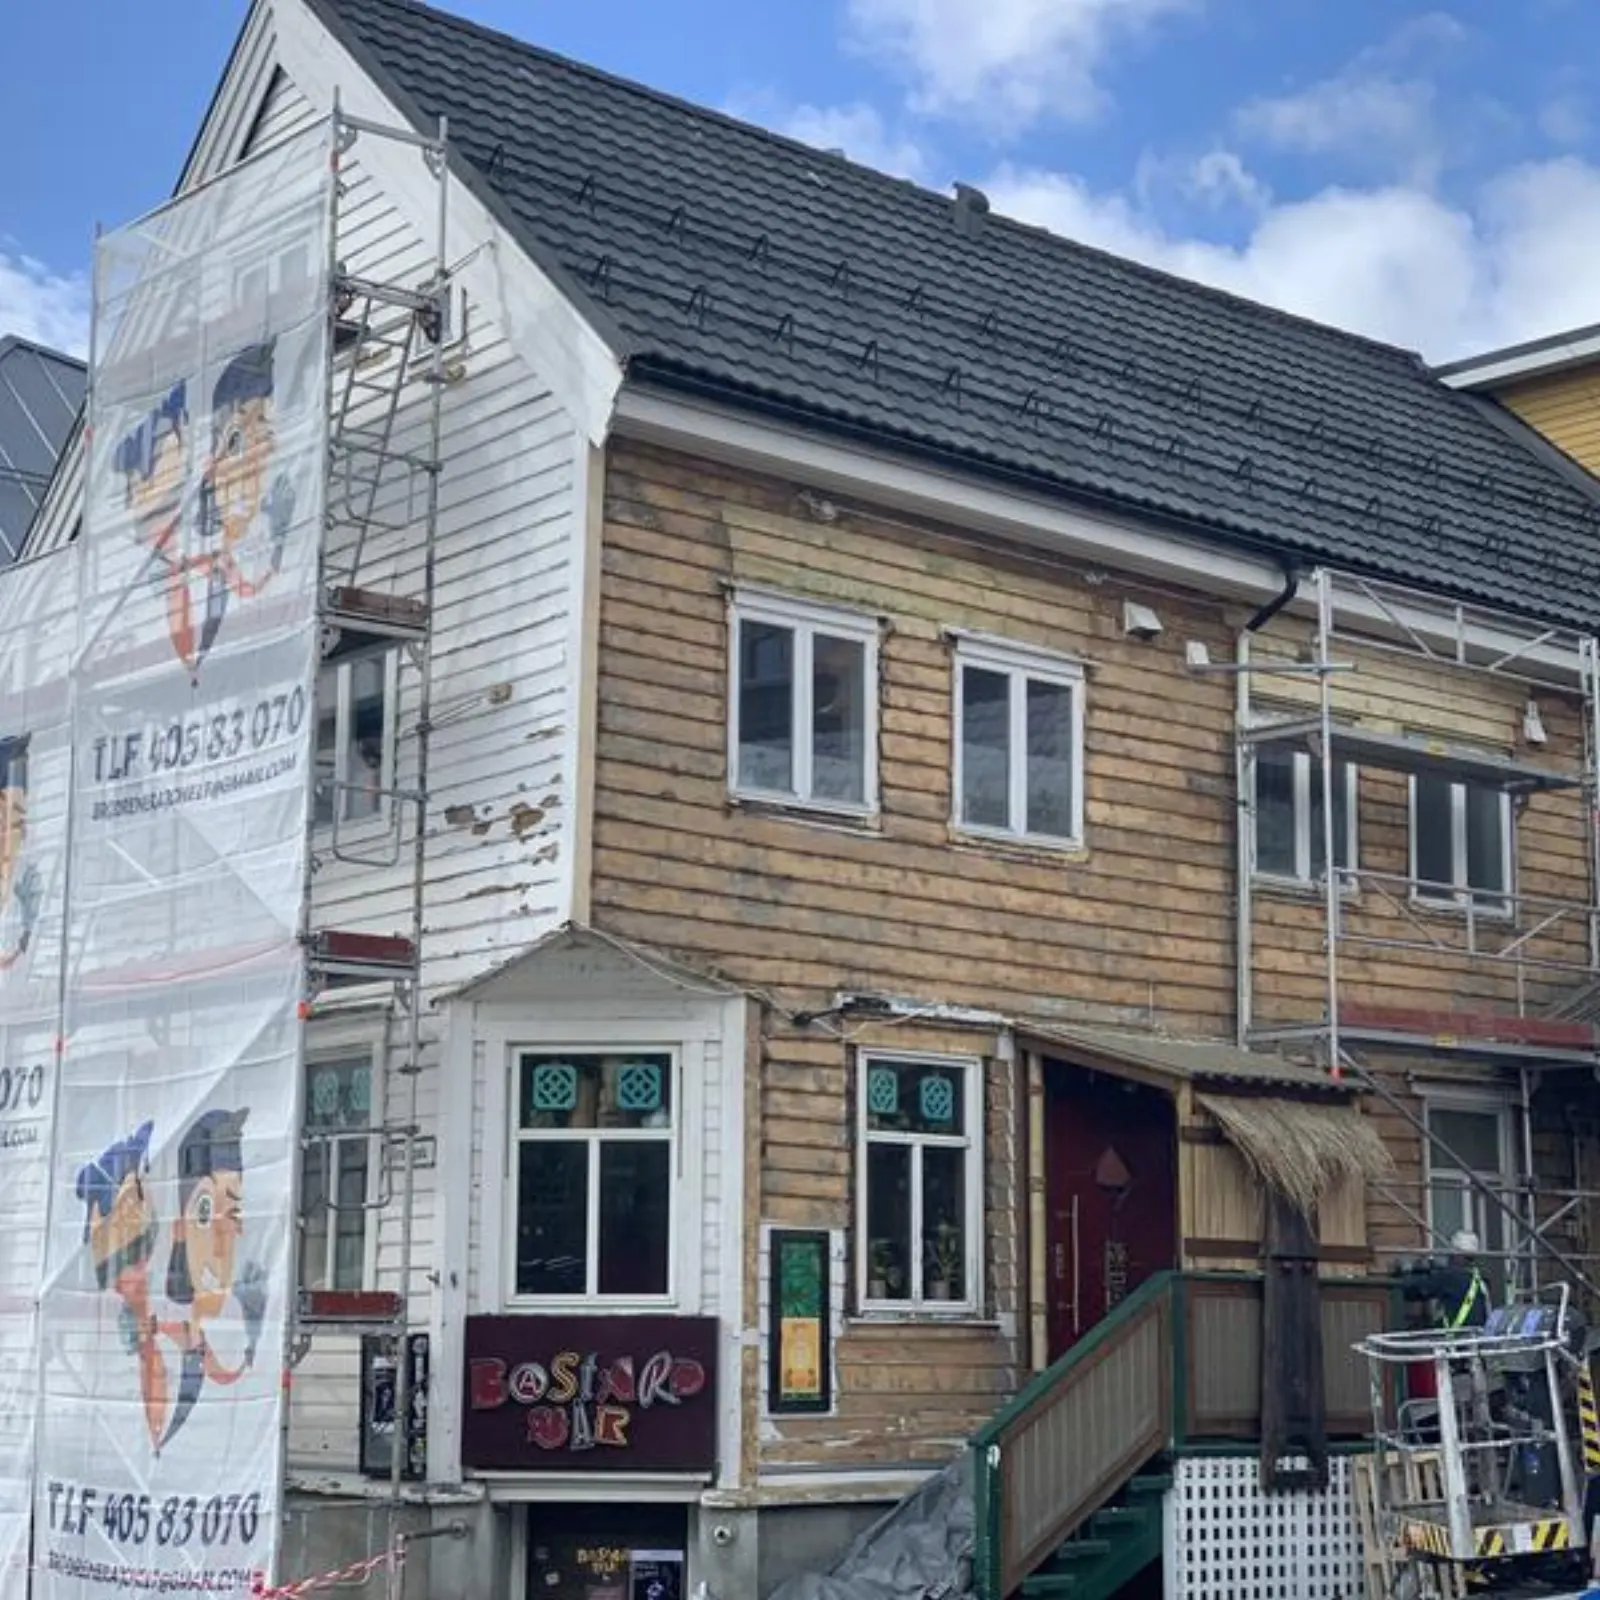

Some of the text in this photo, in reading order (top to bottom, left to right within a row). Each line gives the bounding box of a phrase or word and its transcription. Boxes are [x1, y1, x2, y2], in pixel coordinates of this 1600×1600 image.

[93, 684, 304, 781] TLF 405 83 070
[48, 1481, 261, 1547] TLF 405 83 070
